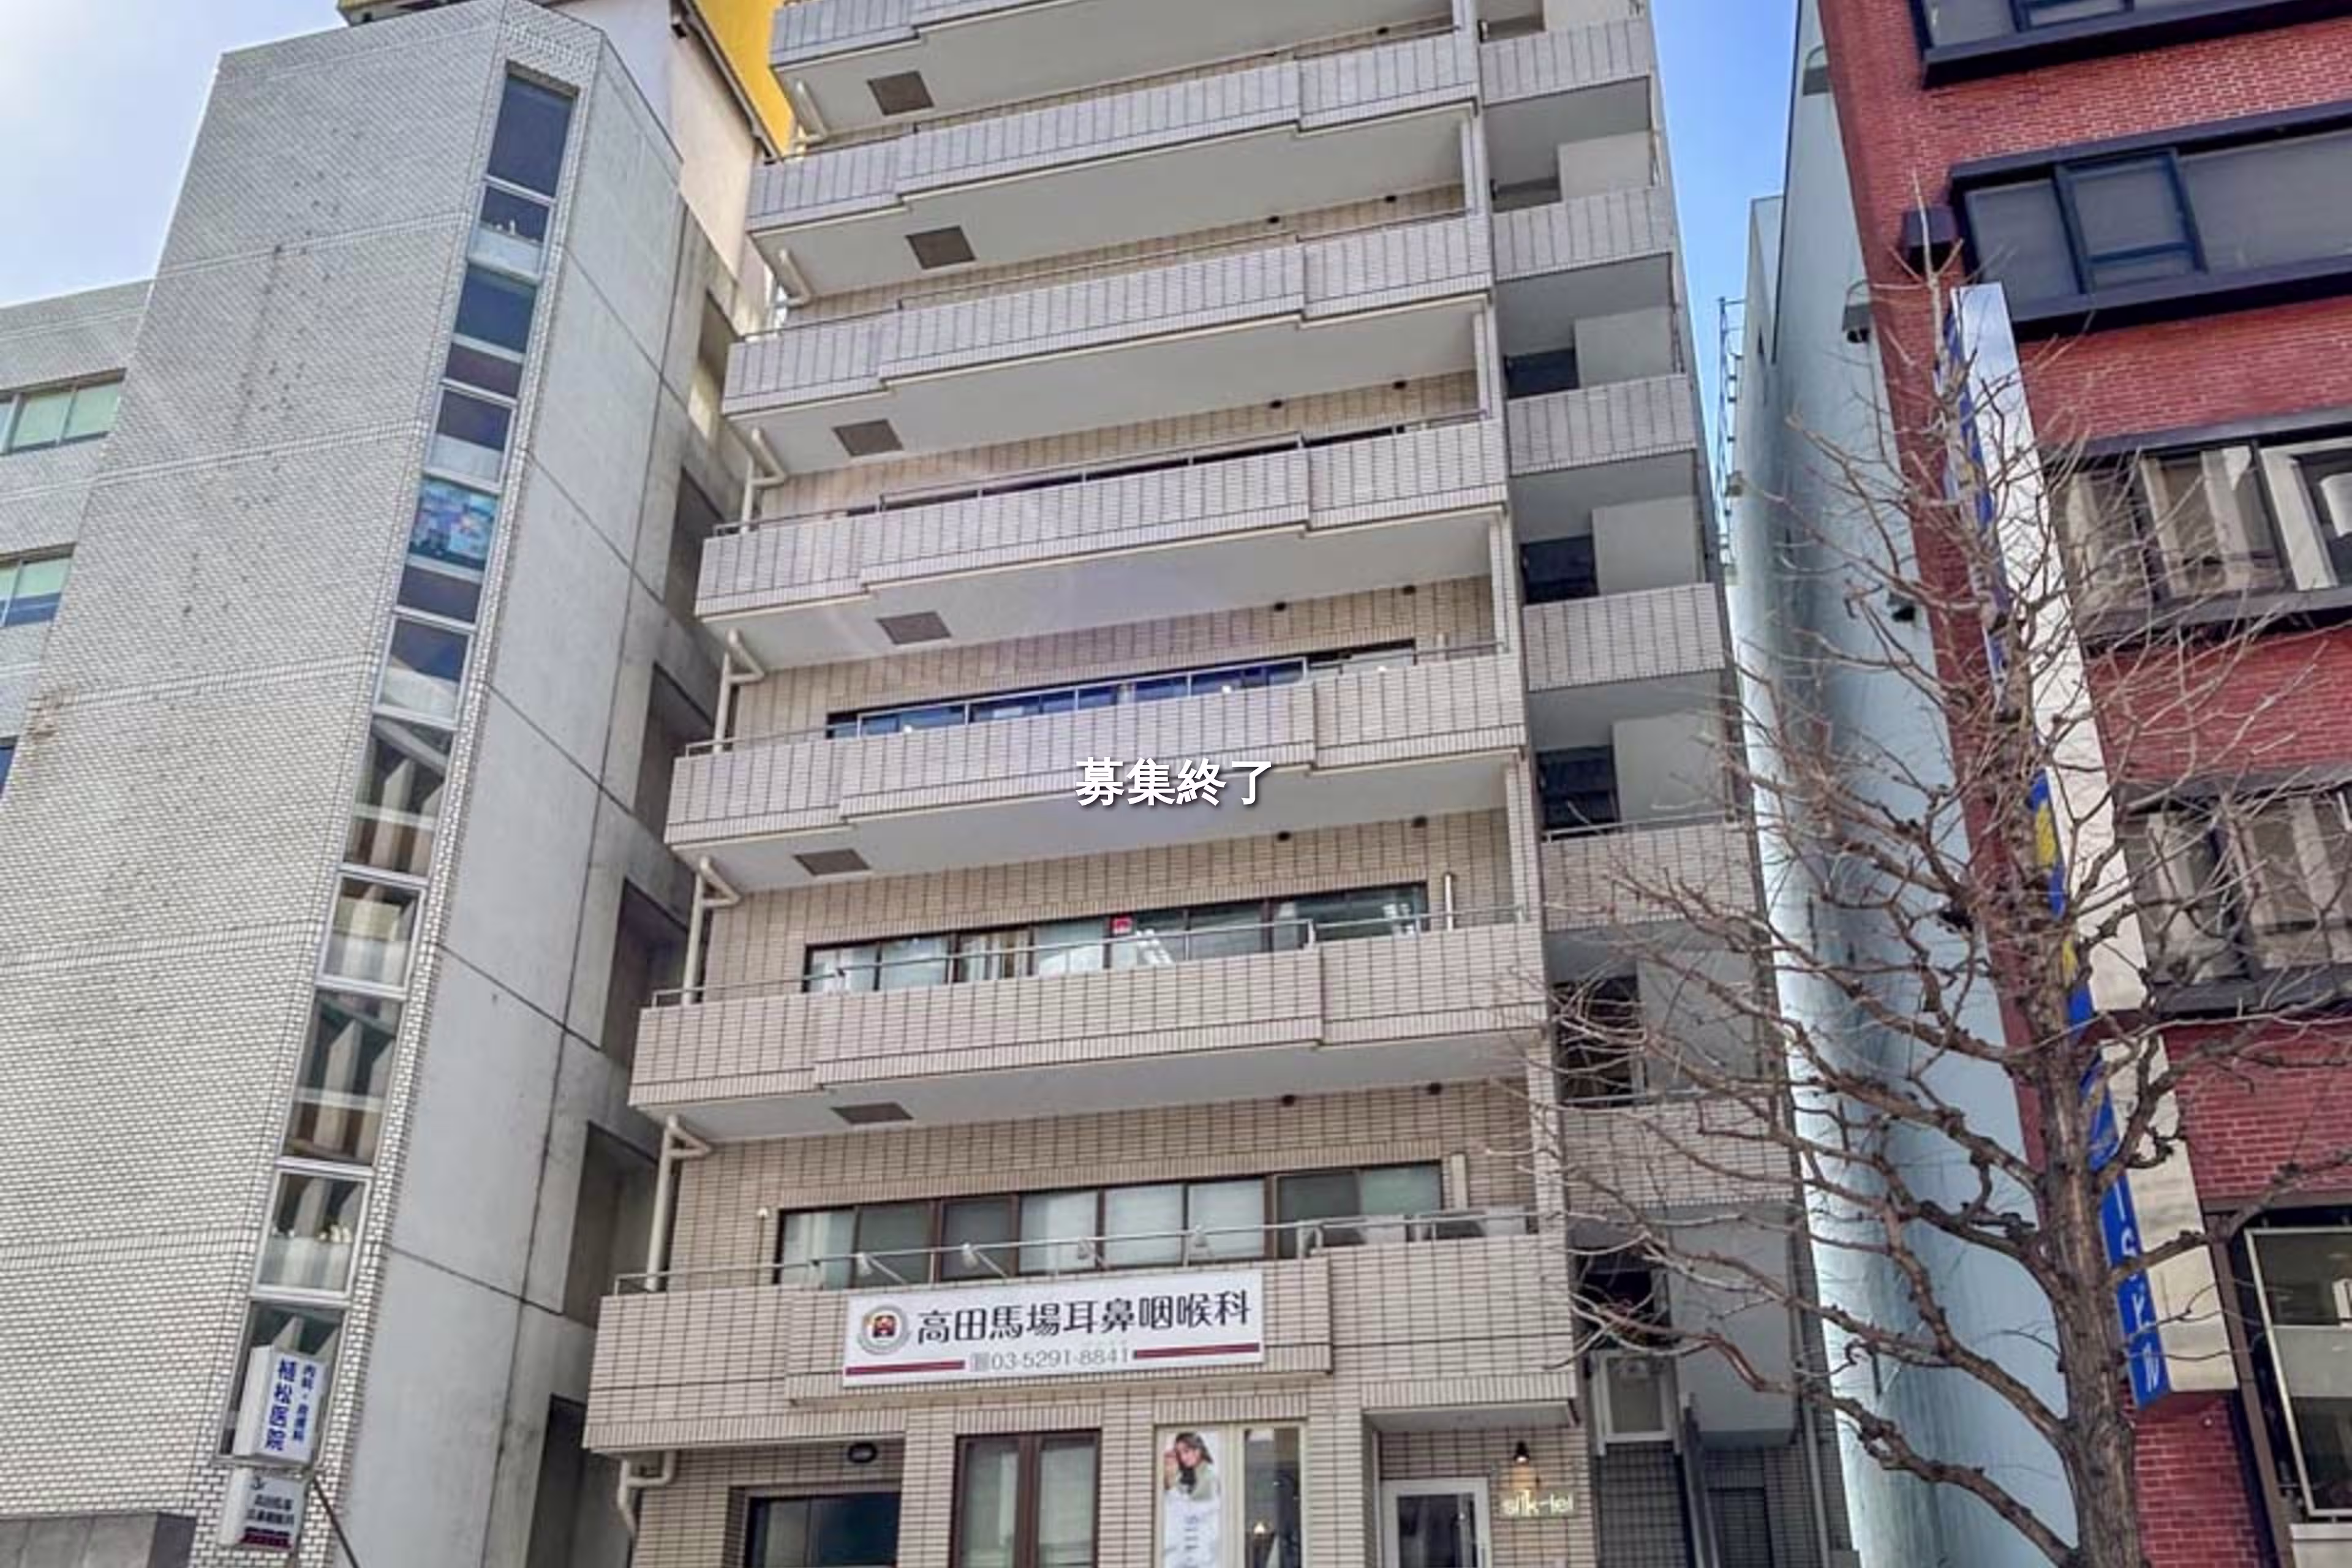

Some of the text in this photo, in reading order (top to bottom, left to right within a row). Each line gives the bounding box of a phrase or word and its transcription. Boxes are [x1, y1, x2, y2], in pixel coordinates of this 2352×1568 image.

[917, 1289, 1251, 1344] 高田馬場耳鼻咽喉科
